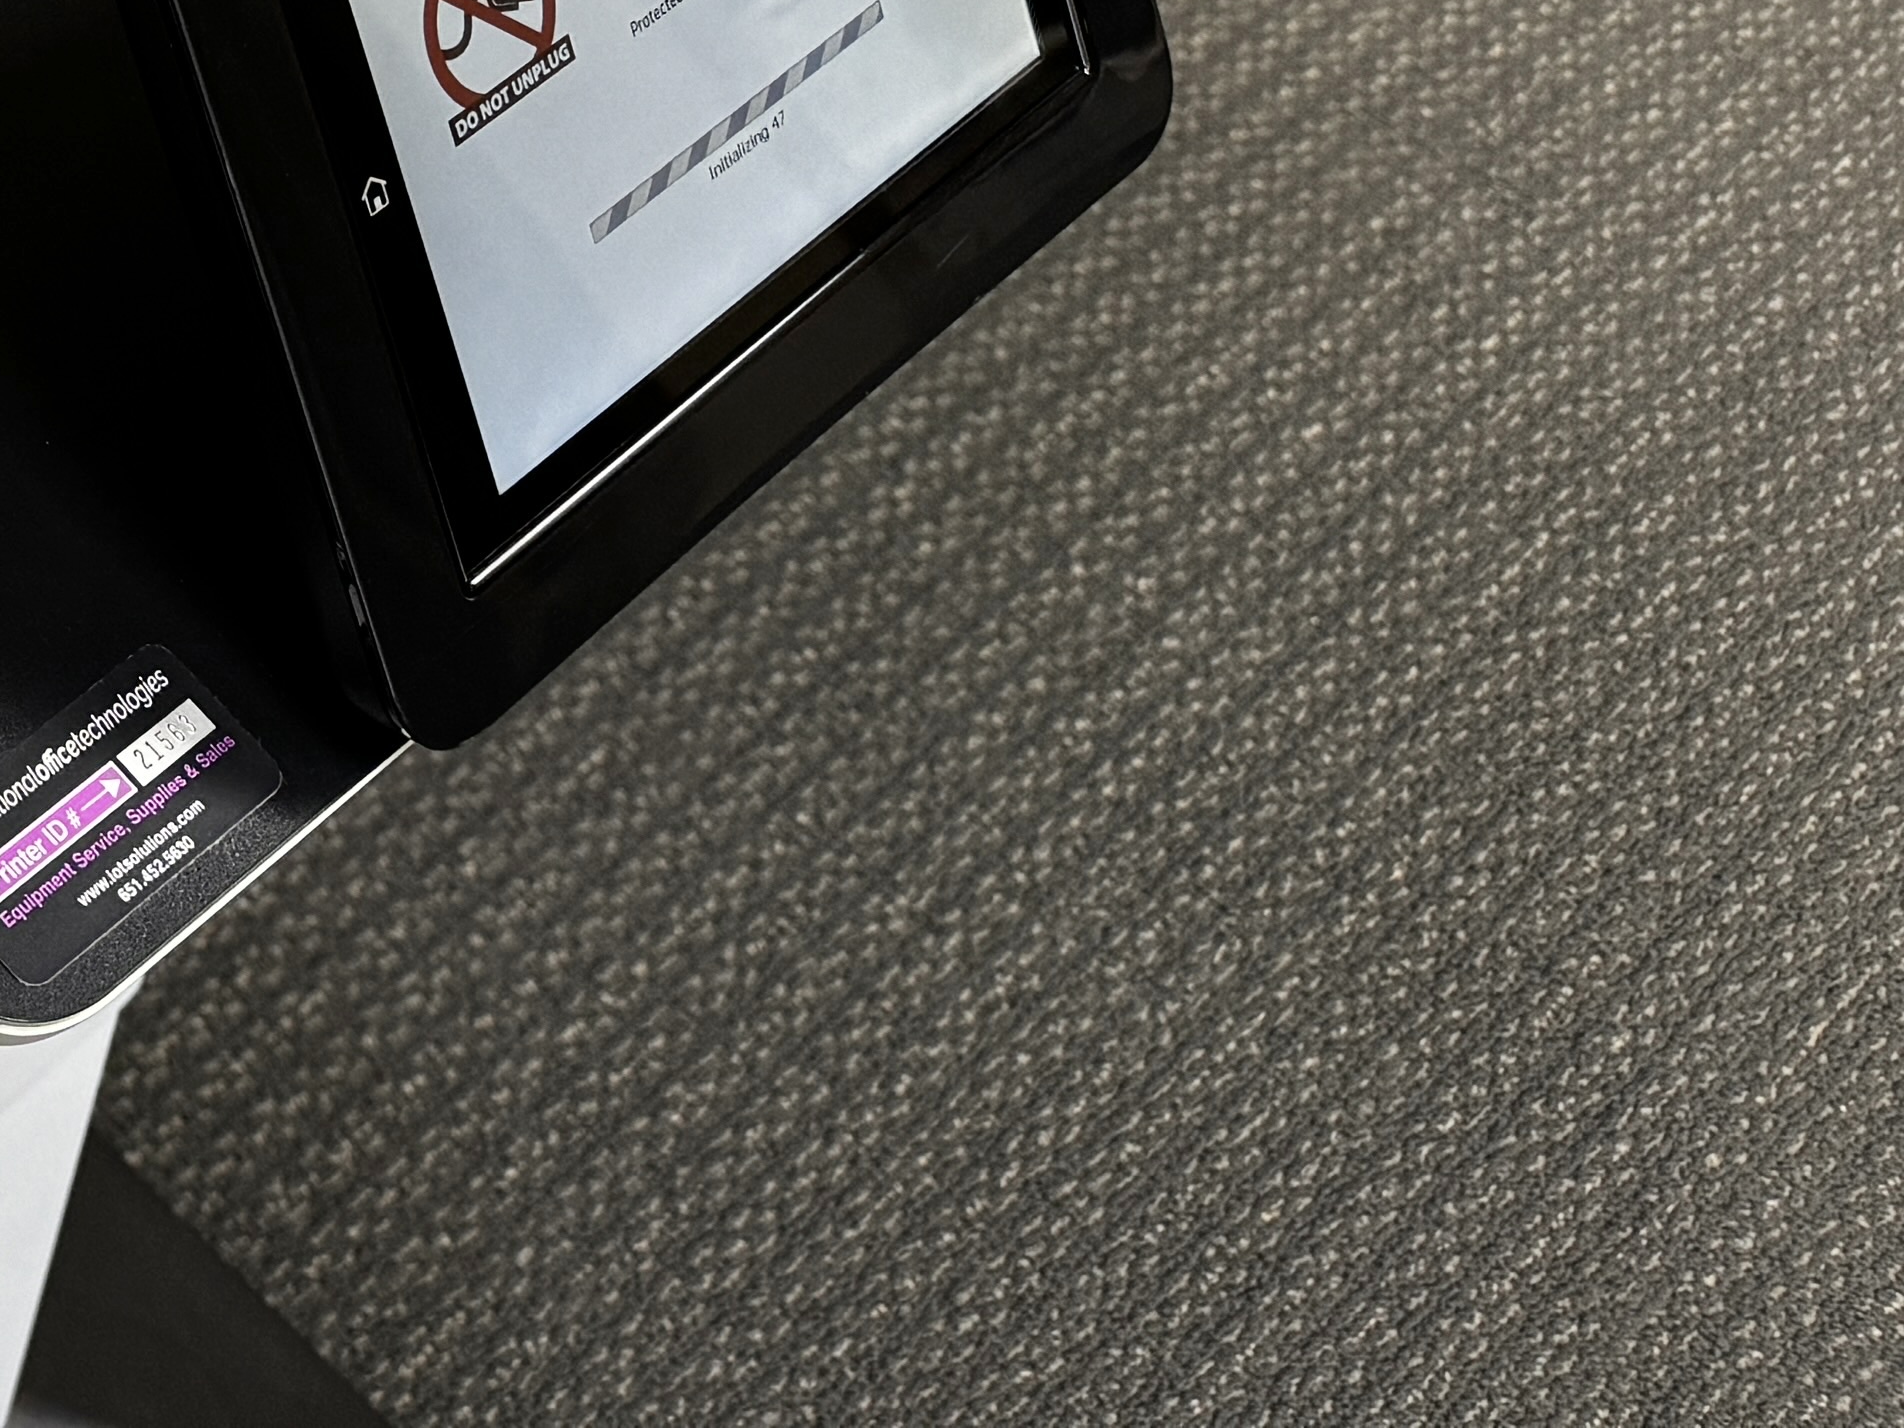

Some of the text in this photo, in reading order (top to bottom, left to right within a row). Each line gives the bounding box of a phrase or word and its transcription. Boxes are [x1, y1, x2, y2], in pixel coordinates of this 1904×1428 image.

[454, 43, 570, 138] DO NOT UNPLUG
[708, 127, 770, 180] Initializing
[133, 714, 197, 770] 21563
[0, 735, 236, 928] Equipment Service, Supplies & Sales
[42, 819, 69, 846] ID
